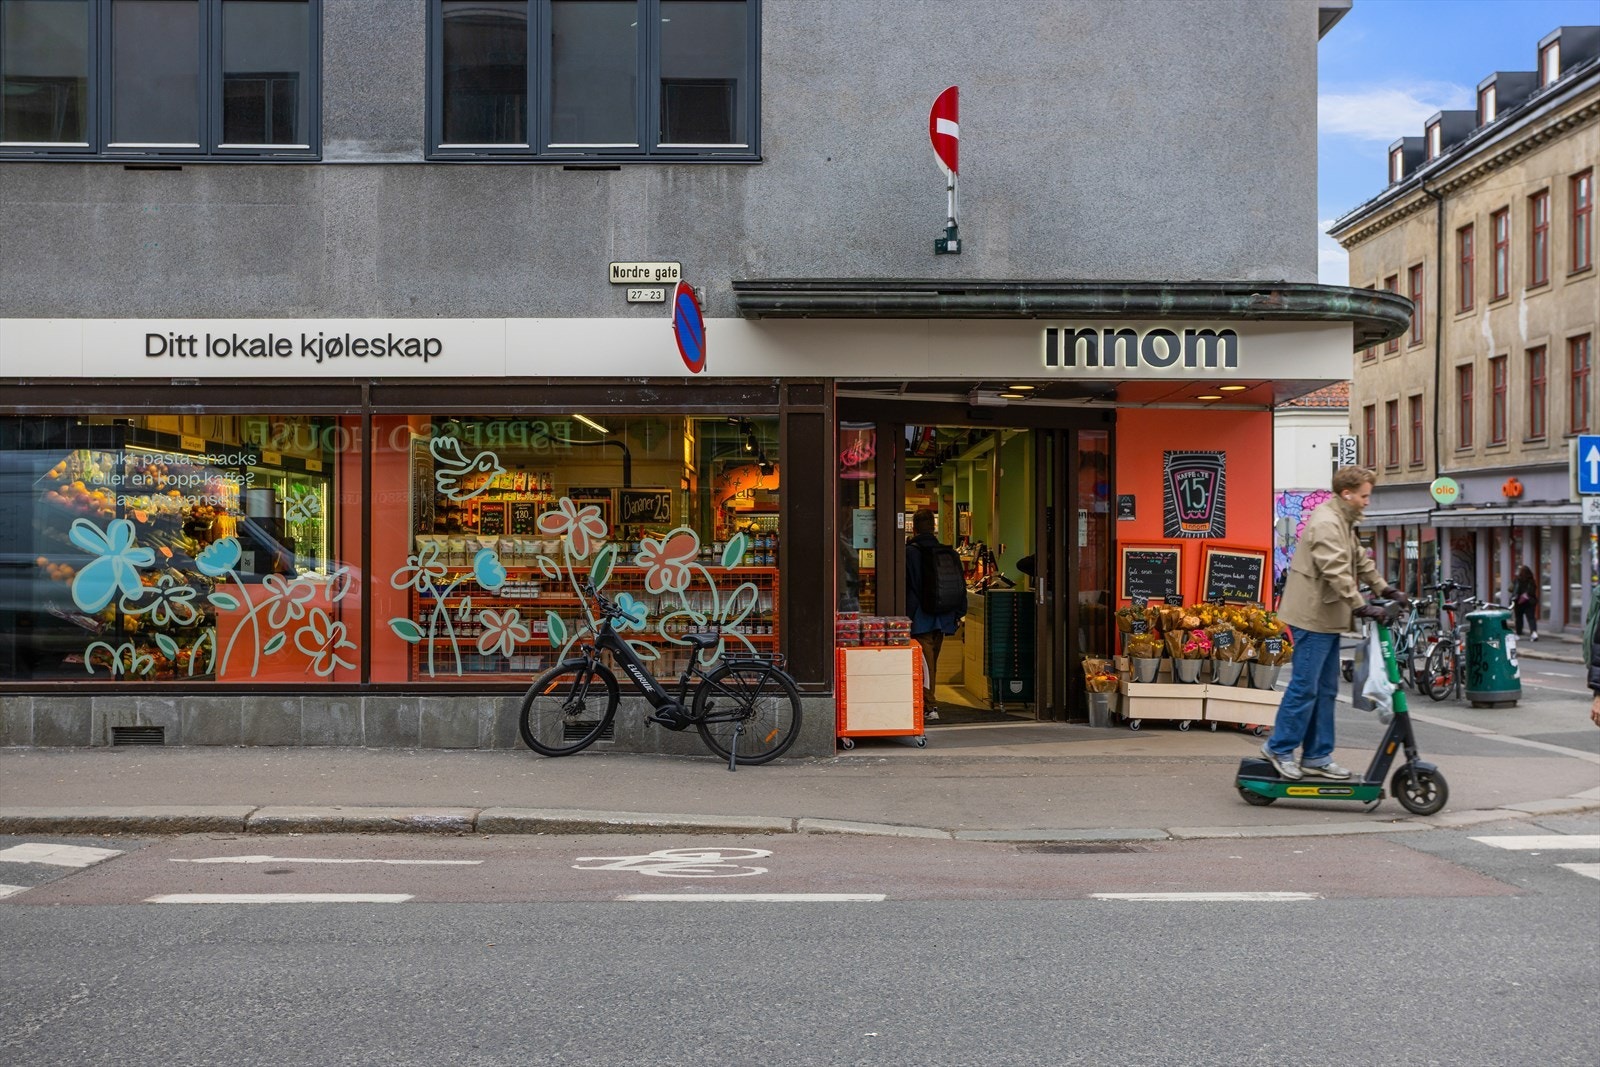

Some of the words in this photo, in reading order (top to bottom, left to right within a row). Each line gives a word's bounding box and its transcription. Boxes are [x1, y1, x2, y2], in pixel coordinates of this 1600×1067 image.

[613, 265, 650, 278] Nordre
[655, 266, 678, 281] gate
[145, 331, 198, 358] Ditt
[205, 333, 293, 358] lokale
[301, 331, 443, 363] kjøleskap
[1046, 327, 1238, 368] innom
[143, 452, 193, 468] pasta,
[197, 451, 257, 466] snacks
[92, 471, 129, 486] eller
[131, 474, 153, 486] en
[157, 471, 201, 489] kopp
[204, 471, 255, 486] kaffe?
[1435, 485, 1455, 495] olio
[624, 495, 655, 520] Bananer
